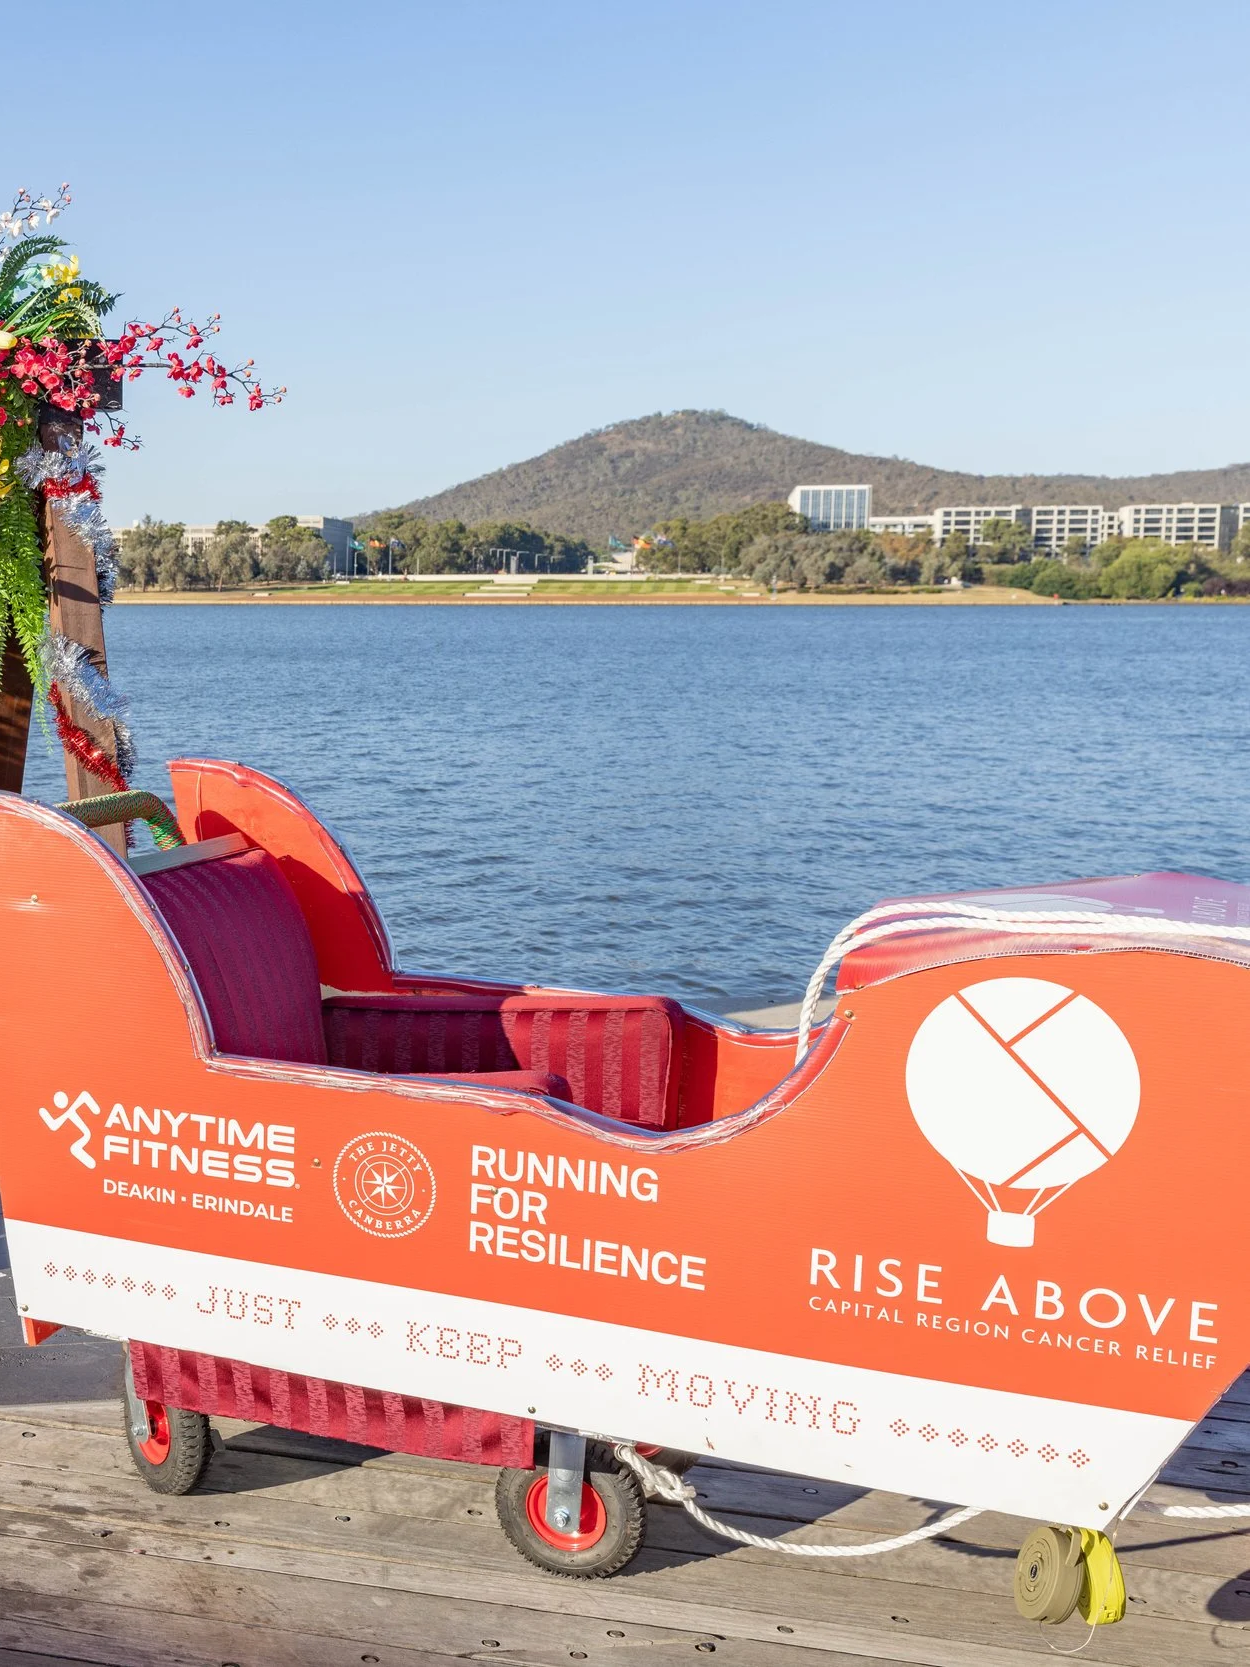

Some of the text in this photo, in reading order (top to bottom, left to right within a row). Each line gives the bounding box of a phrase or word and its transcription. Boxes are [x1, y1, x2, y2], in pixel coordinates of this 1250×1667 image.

[104, 1103, 295, 1154] ANYTIME
[103, 1136, 296, 1188] FITNESS
[348, 1140, 422, 1172] THE JETTY
[471, 1144, 659, 1203] RUNNING
[103, 1178, 293, 1223] DEAKIN ERINDALE
[348, 1199, 421, 1230] CANBERRA
[470, 1182, 548, 1225] FOR
[469, 1220, 707, 1291] RESILIENCE
[810, 1247, 1218, 1344] RISE ABOVE
[809, 1296, 1216, 1370] CAPITAL REGION CANCER RELIEF
[196, 1285, 861, 1435] JUST KEEP MOVING
